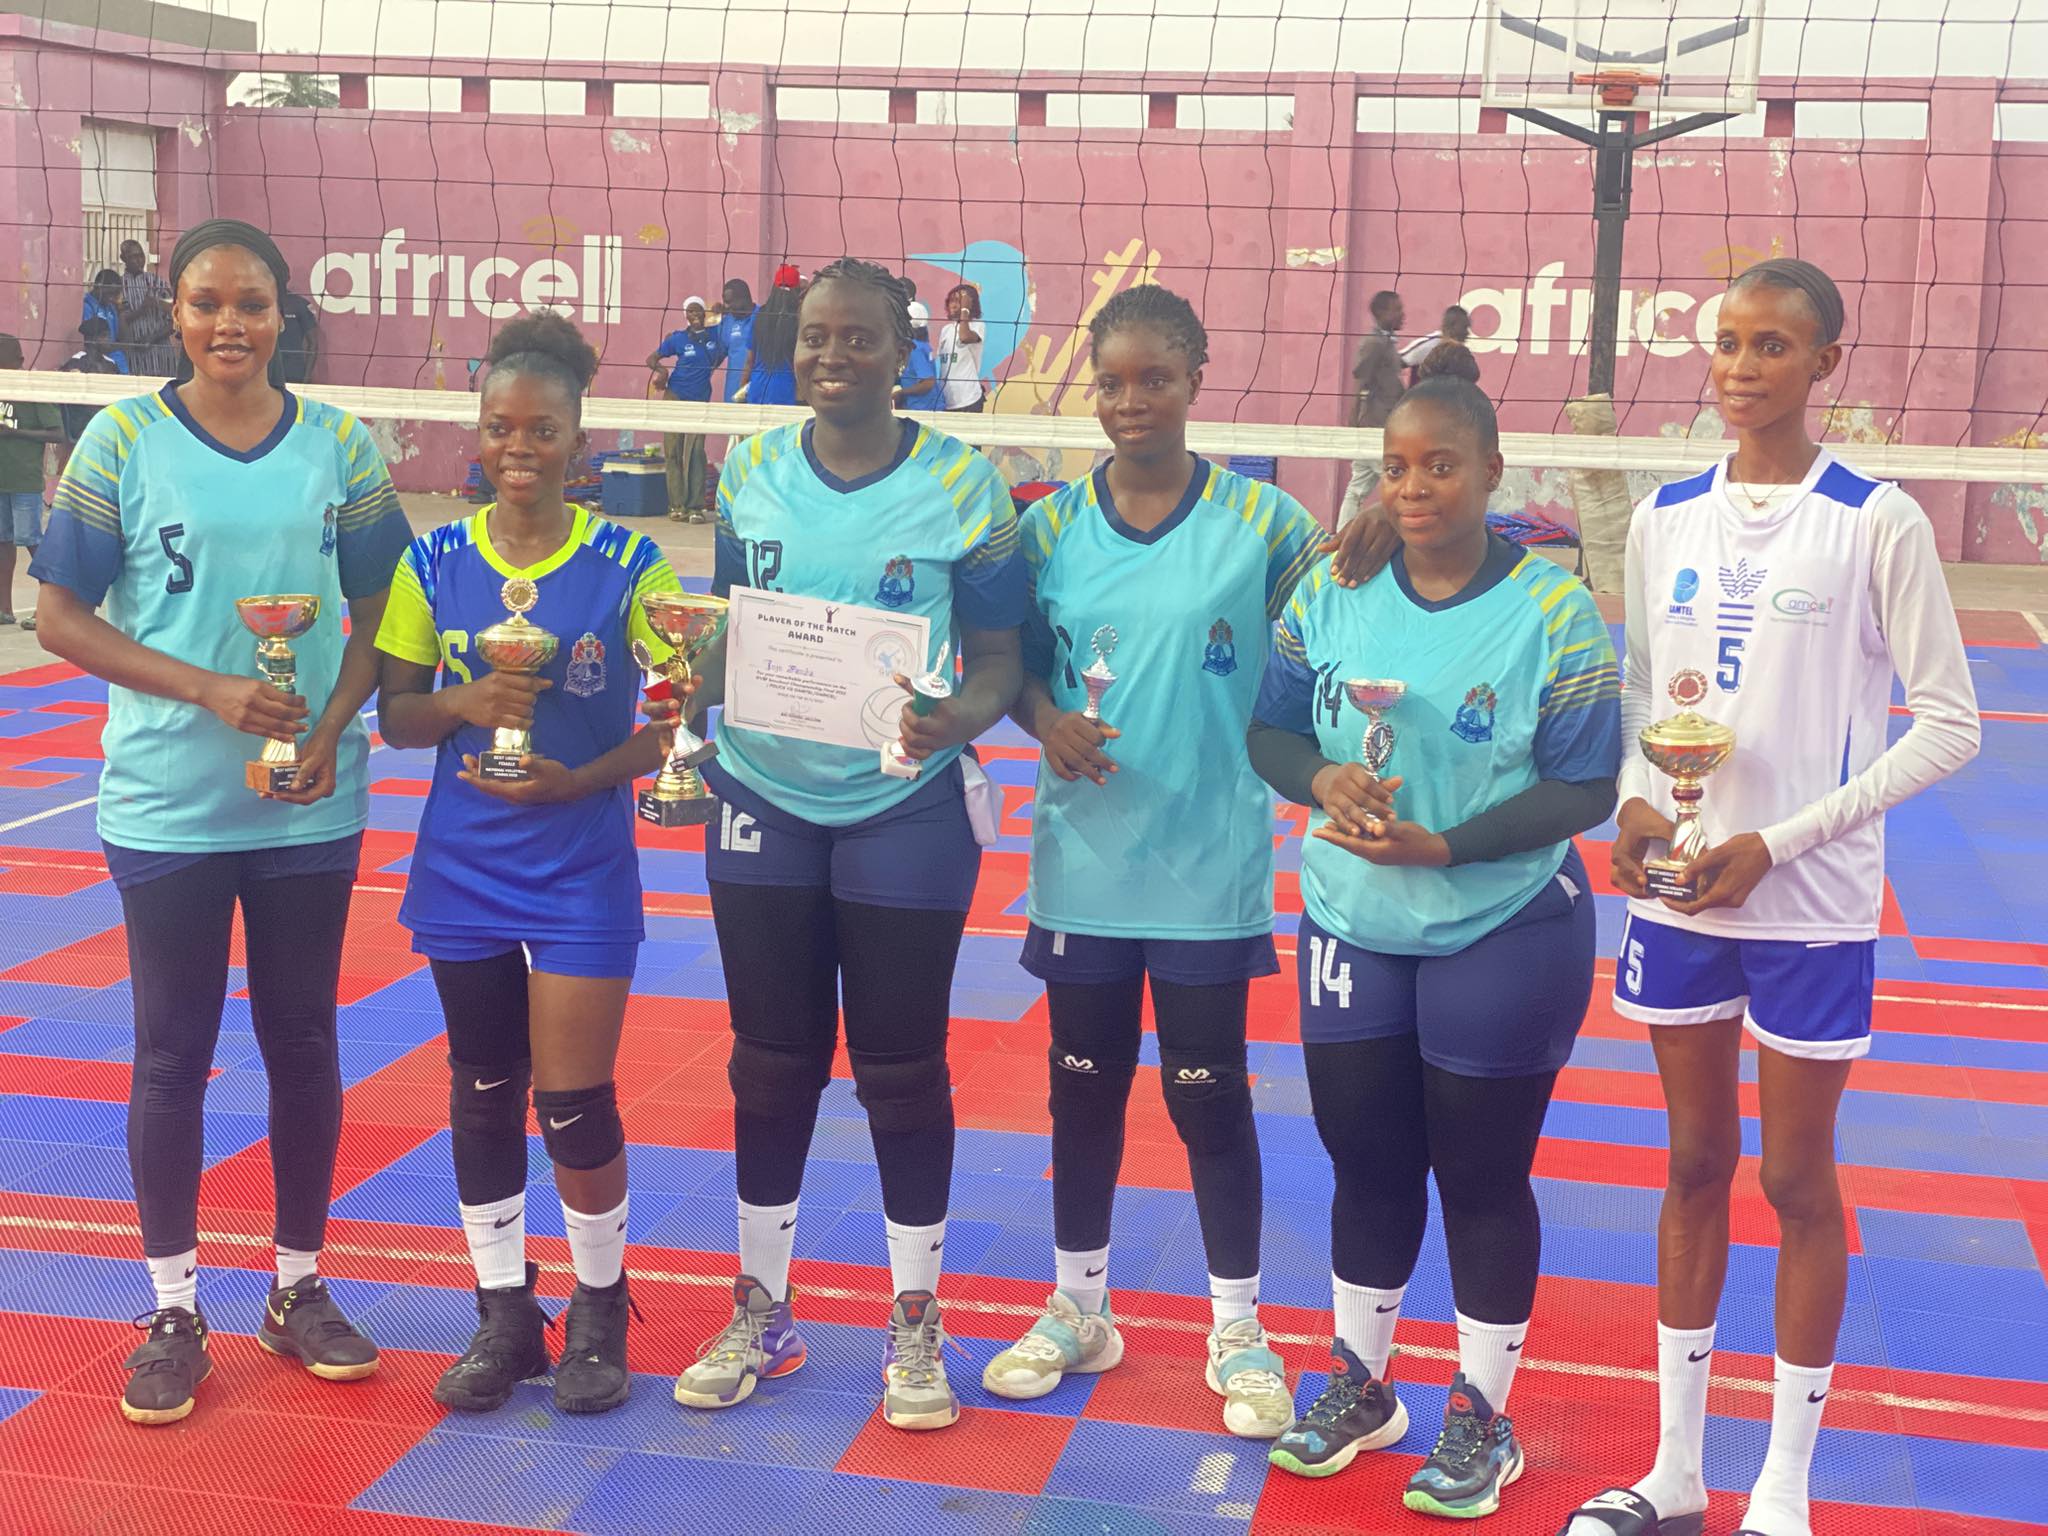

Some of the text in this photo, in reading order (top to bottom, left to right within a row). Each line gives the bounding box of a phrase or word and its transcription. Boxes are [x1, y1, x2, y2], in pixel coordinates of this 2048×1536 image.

[310, 228, 622, 323] africell
[159, 522, 194, 594] 5
[752, 540, 783, 592] 12
[758, 613, 856, 636] PLAYER OF THE MATCH
[788, 630, 824, 643] AWARD
[1716, 636, 1745, 694] 5
[1316, 661, 1342, 728] 14
[1310, 936, 1352, 1008] 14
[1625, 938, 1645, 996] 5
